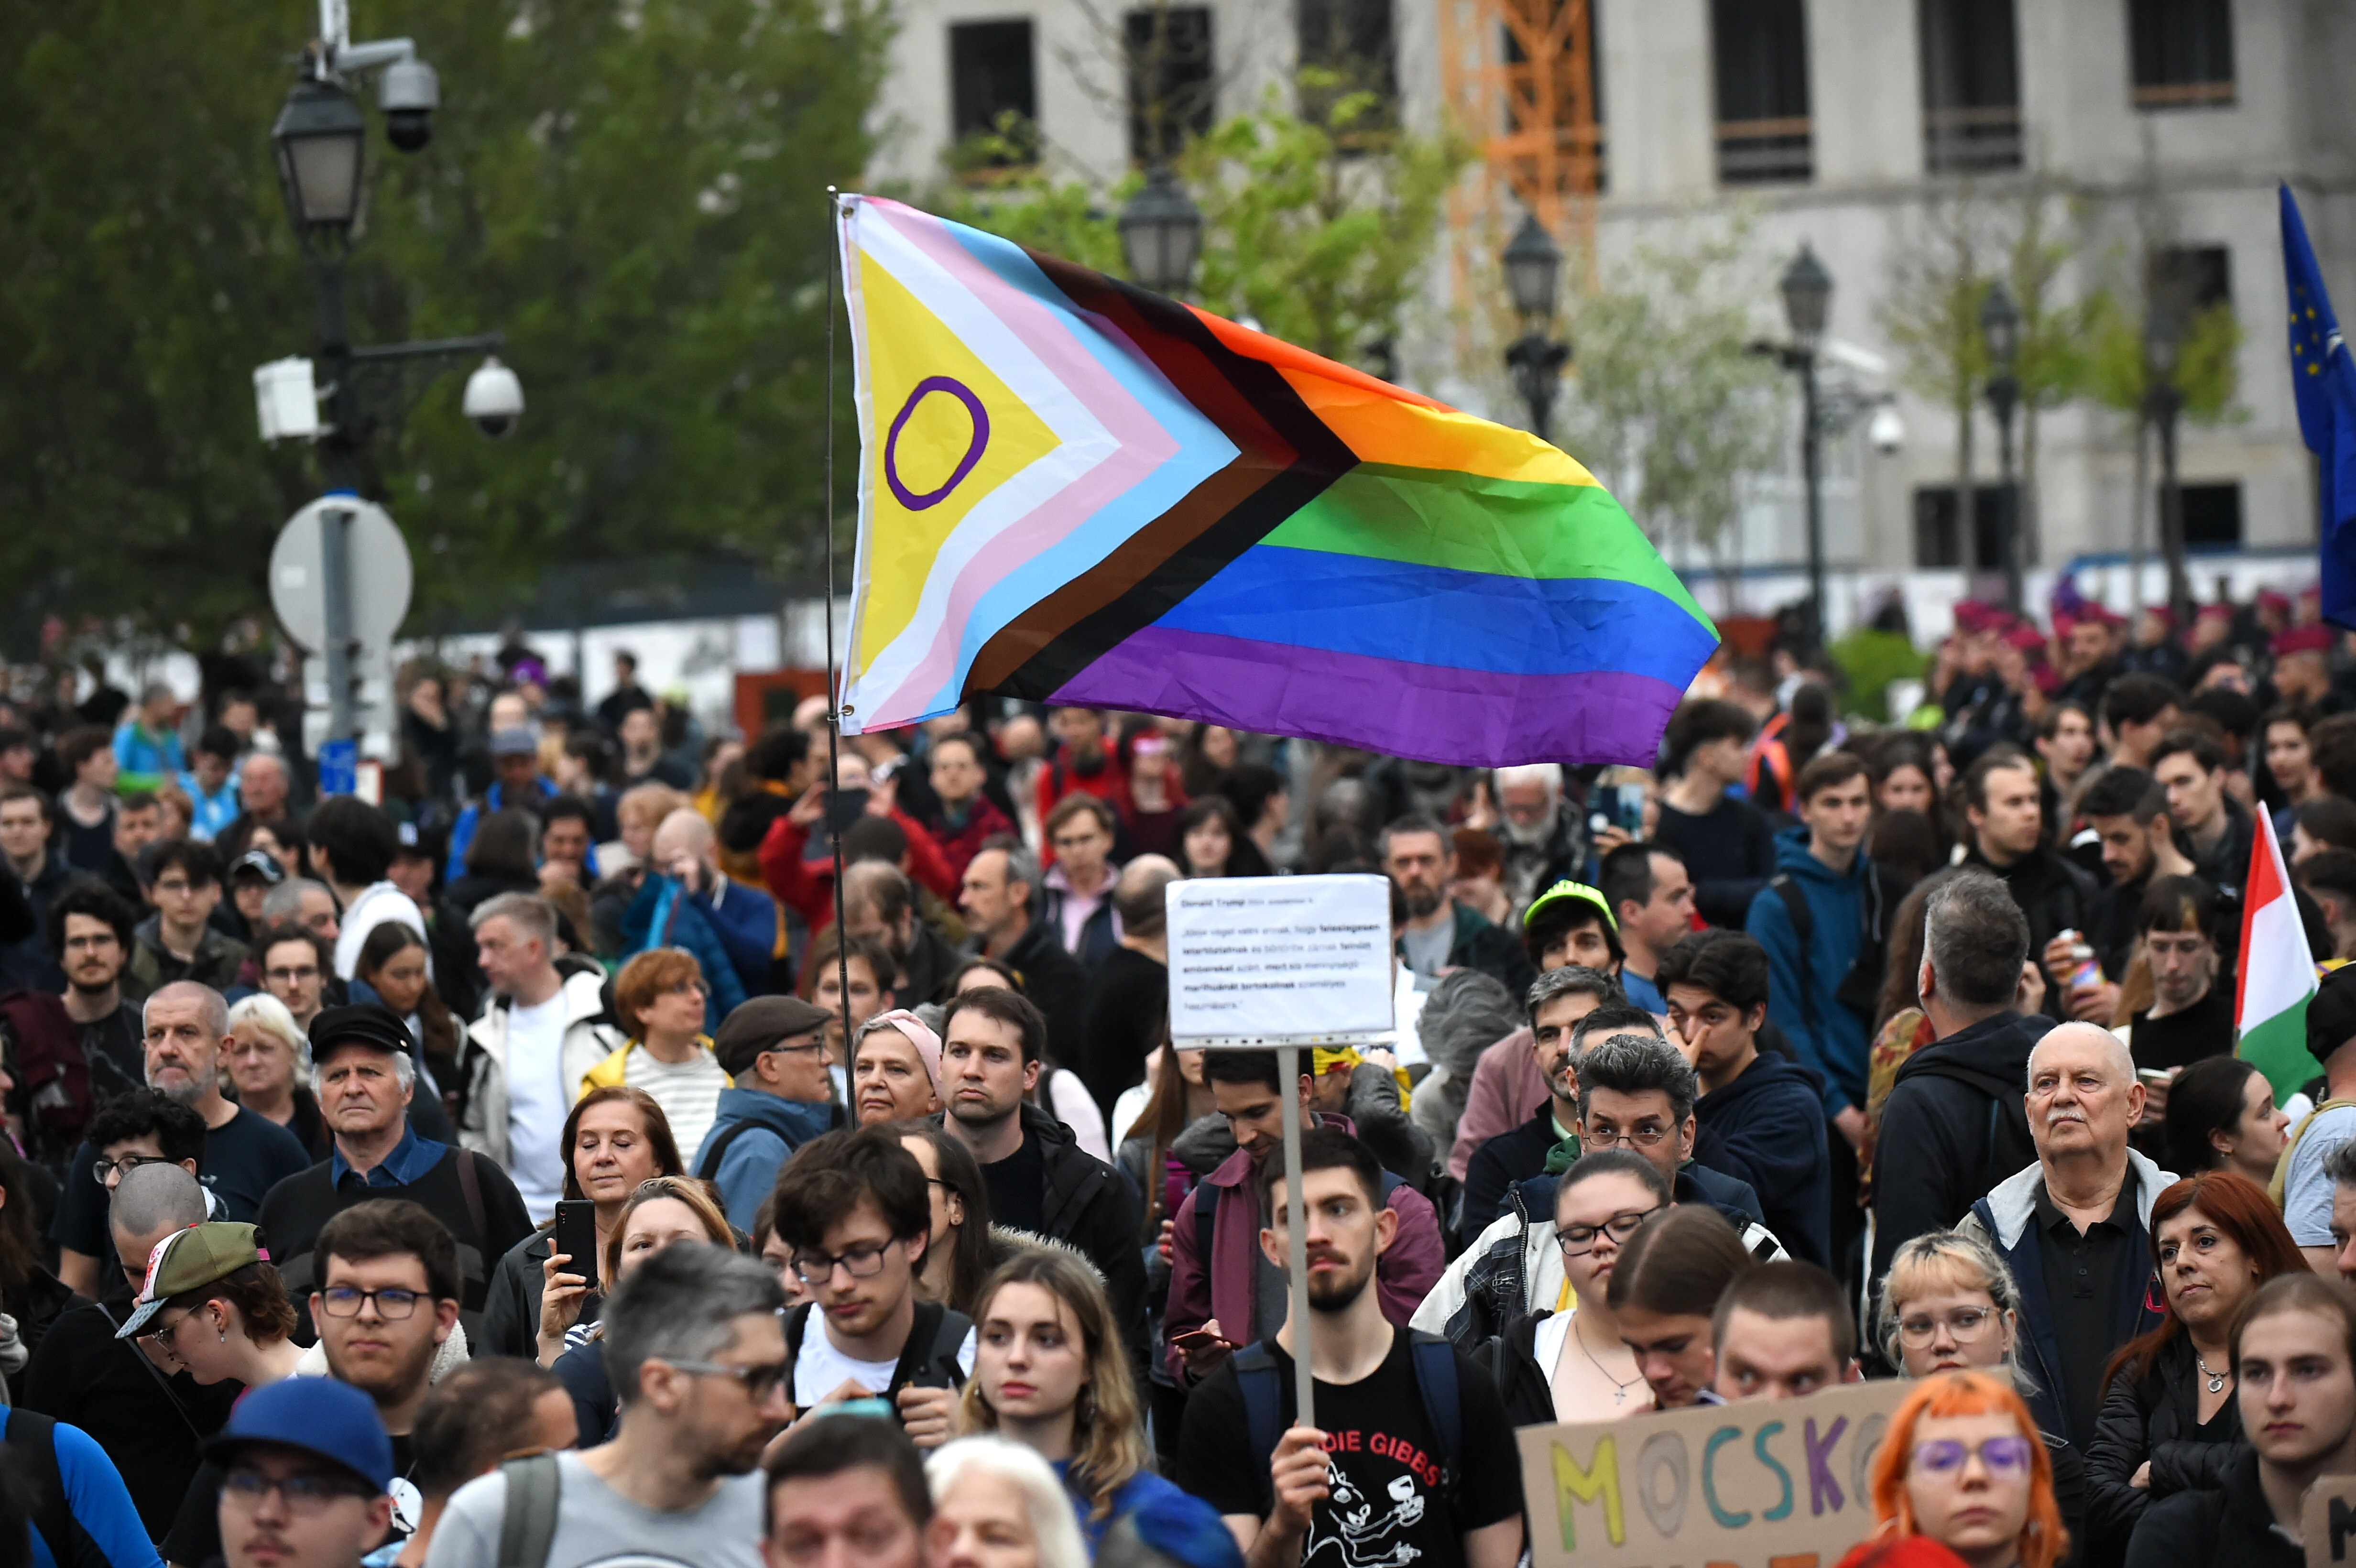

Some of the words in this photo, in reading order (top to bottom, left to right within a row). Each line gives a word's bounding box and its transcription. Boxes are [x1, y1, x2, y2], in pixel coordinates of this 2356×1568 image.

[1181, 899, 1213, 908] Donald
[1217, 899, 1245, 909] Trump
[1318, 1430, 1362, 1452] DIE
[1370, 1432, 1441, 1487] GIBBS
